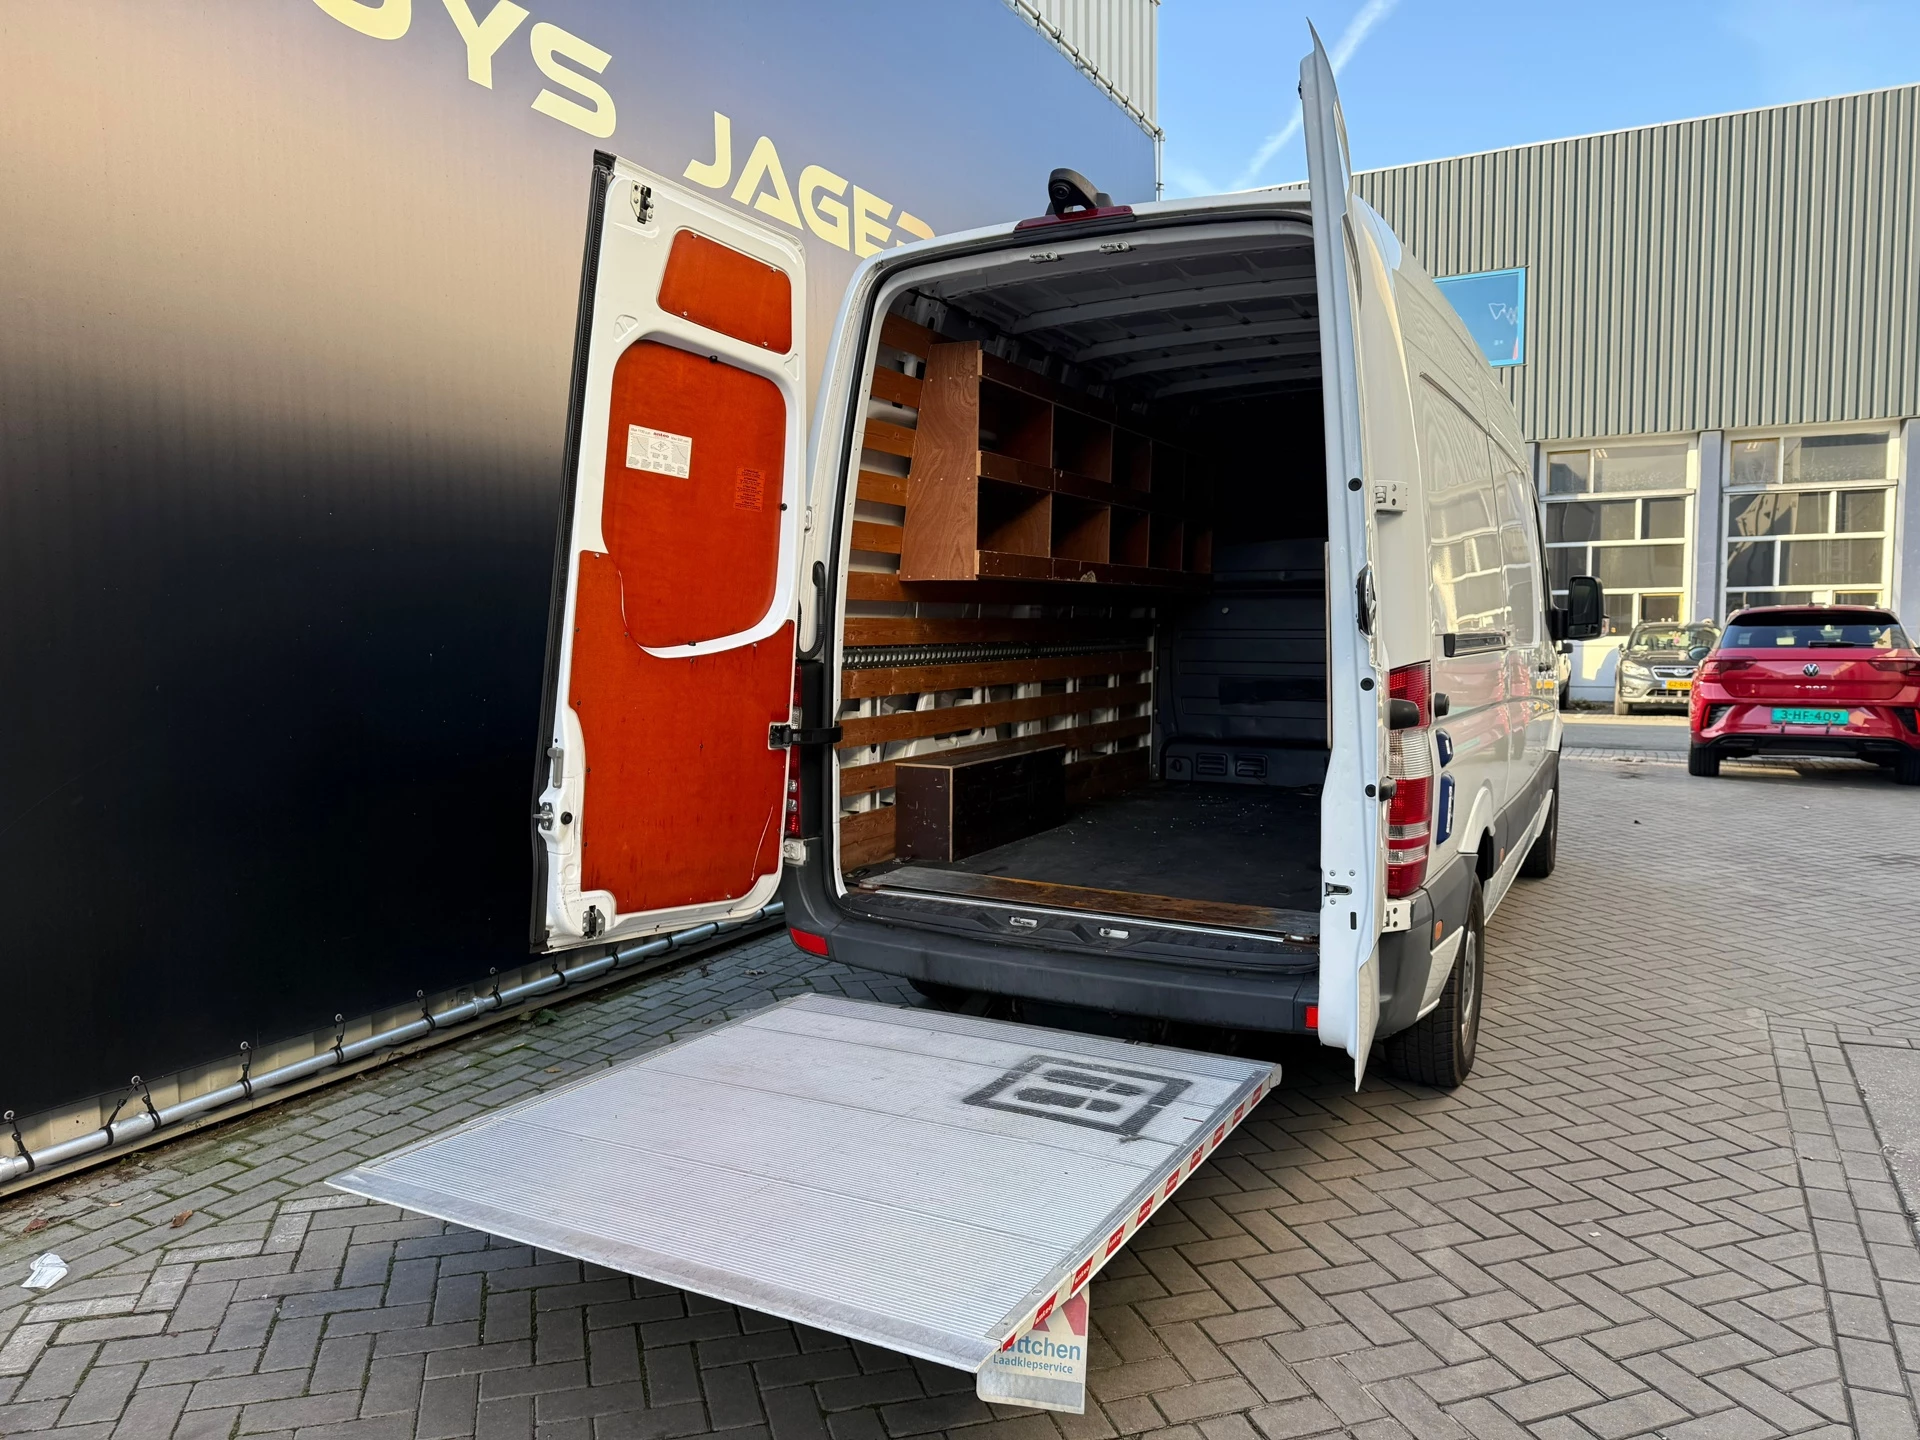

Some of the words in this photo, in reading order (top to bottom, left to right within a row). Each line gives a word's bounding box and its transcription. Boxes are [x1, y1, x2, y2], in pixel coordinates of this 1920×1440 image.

[1780, 709, 1841, 721] 3-HF-409
[1074, 1265, 1090, 1284] anteo
[1034, 1304, 1053, 1325] anteo
[993, 1354, 1073, 1374] Laadklepservice
